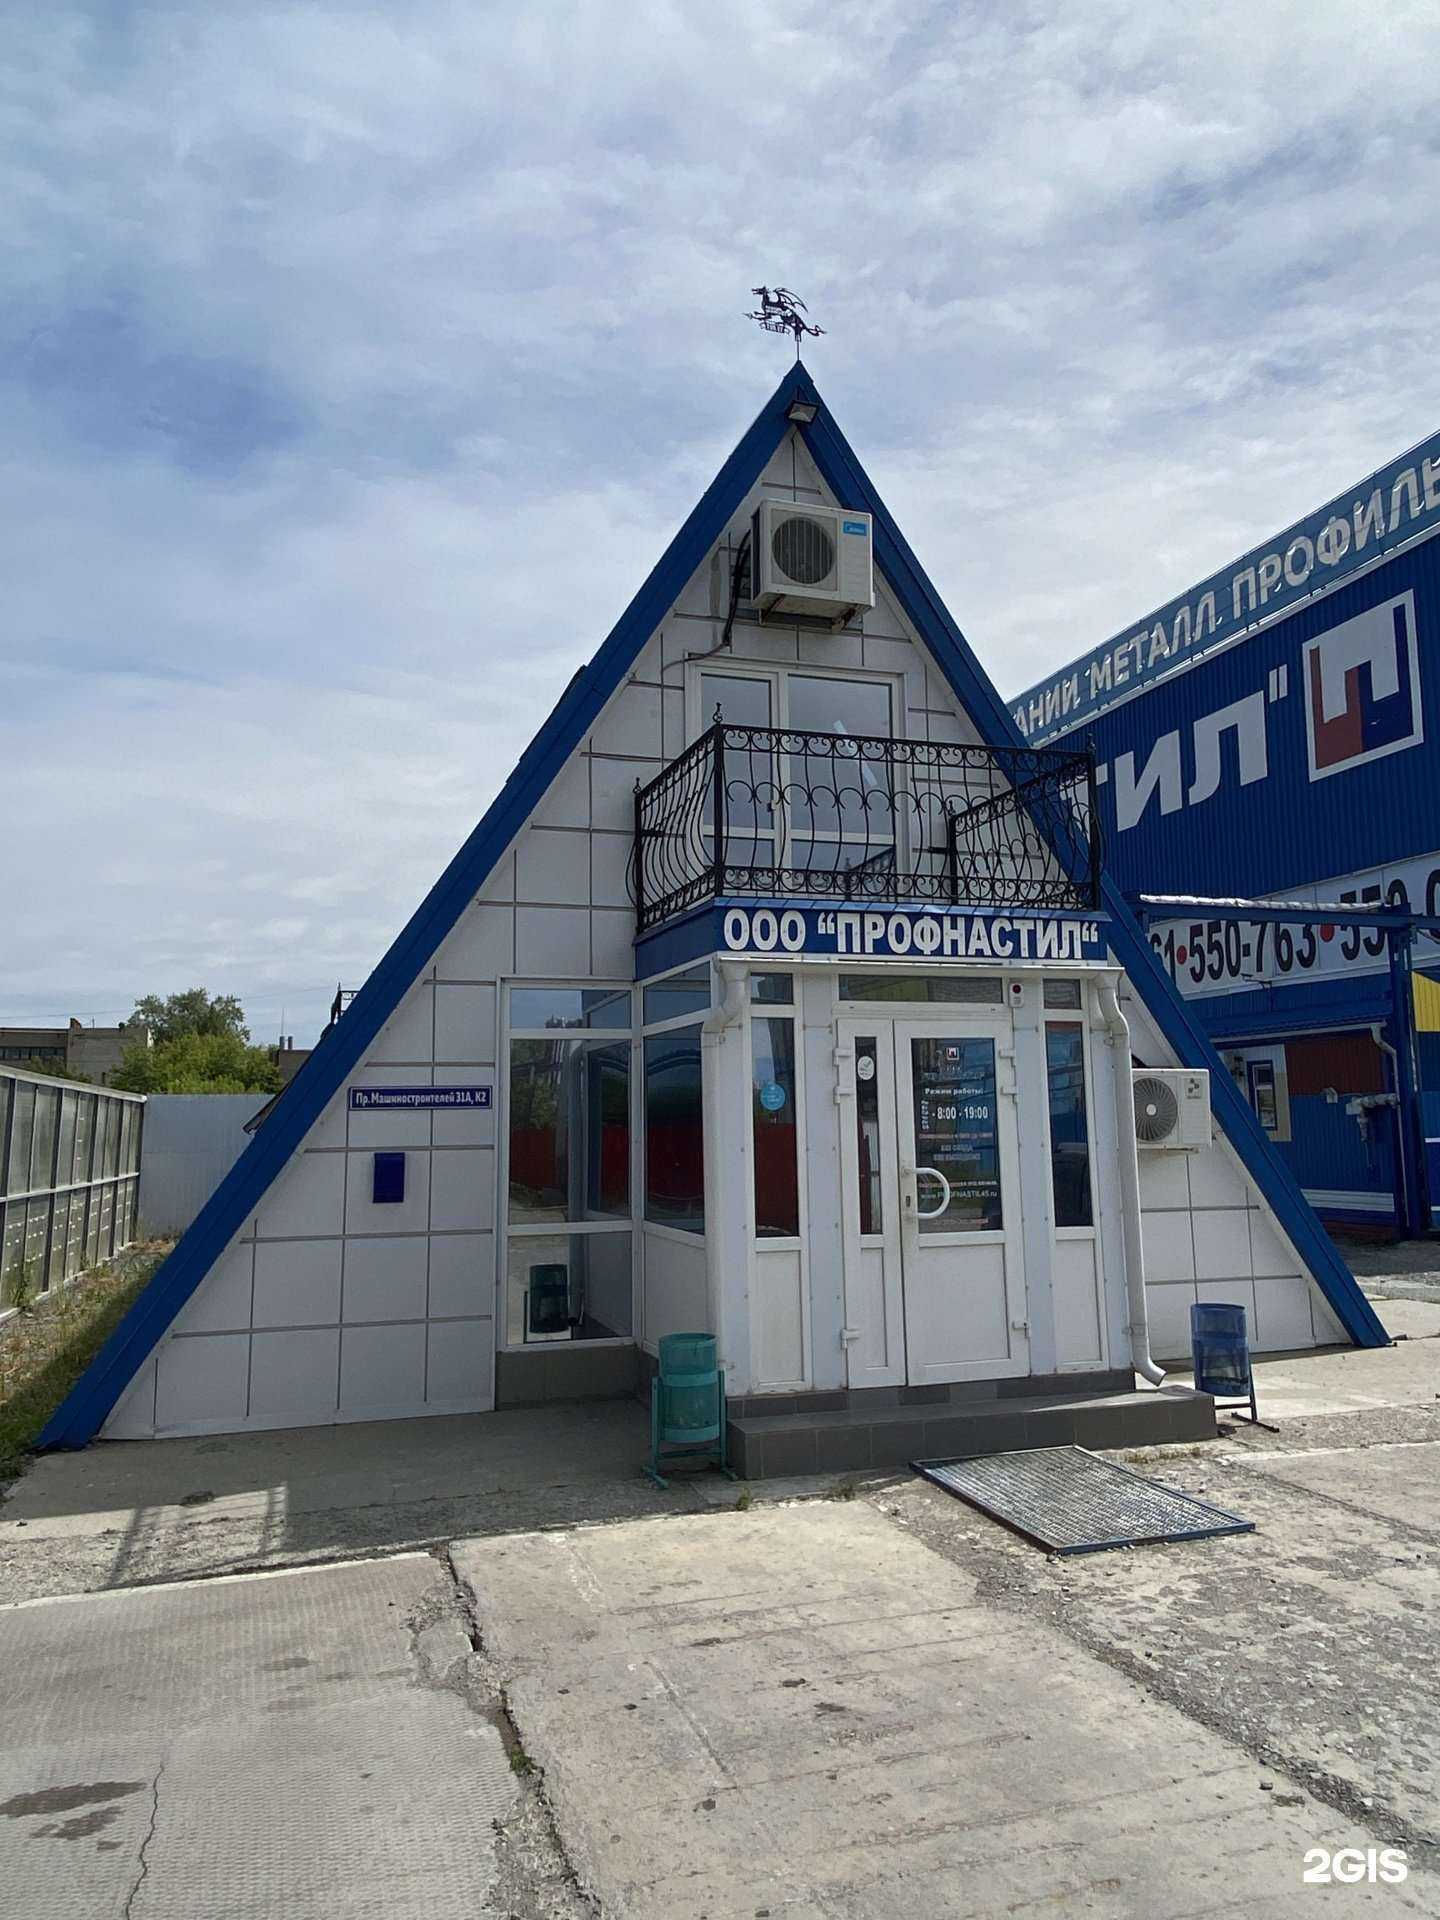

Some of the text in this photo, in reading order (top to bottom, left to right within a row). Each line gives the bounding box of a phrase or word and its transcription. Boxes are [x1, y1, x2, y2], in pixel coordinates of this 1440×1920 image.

[1089, 591, 1217, 700] МЕТАЛЛ
[723, 908, 806, 951] ООО
[356, 1093, 370, 1106] Пр.
[371, 1091, 455, 1106] Машиностроителей
[937, 1106, 957, 1119] 8:00
[964, 1106, 988, 1119] 19:00
